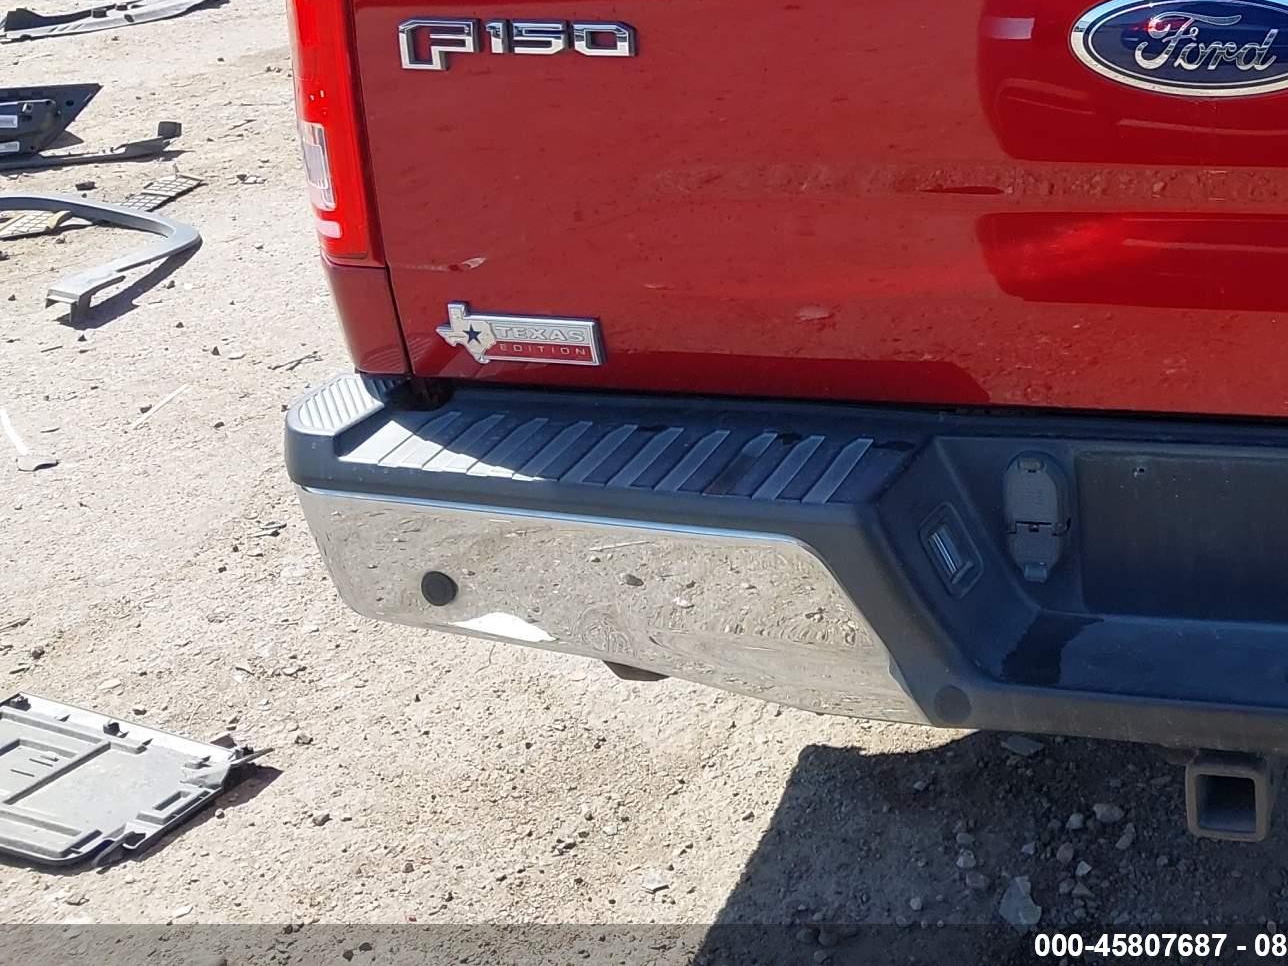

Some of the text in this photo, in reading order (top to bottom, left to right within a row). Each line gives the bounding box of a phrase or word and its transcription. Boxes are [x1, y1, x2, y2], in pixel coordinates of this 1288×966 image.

[1135, 11, 1279, 71] Ford
[494, 326, 586, 343] TEXAS
[499, 343, 587, 356] EDITION
